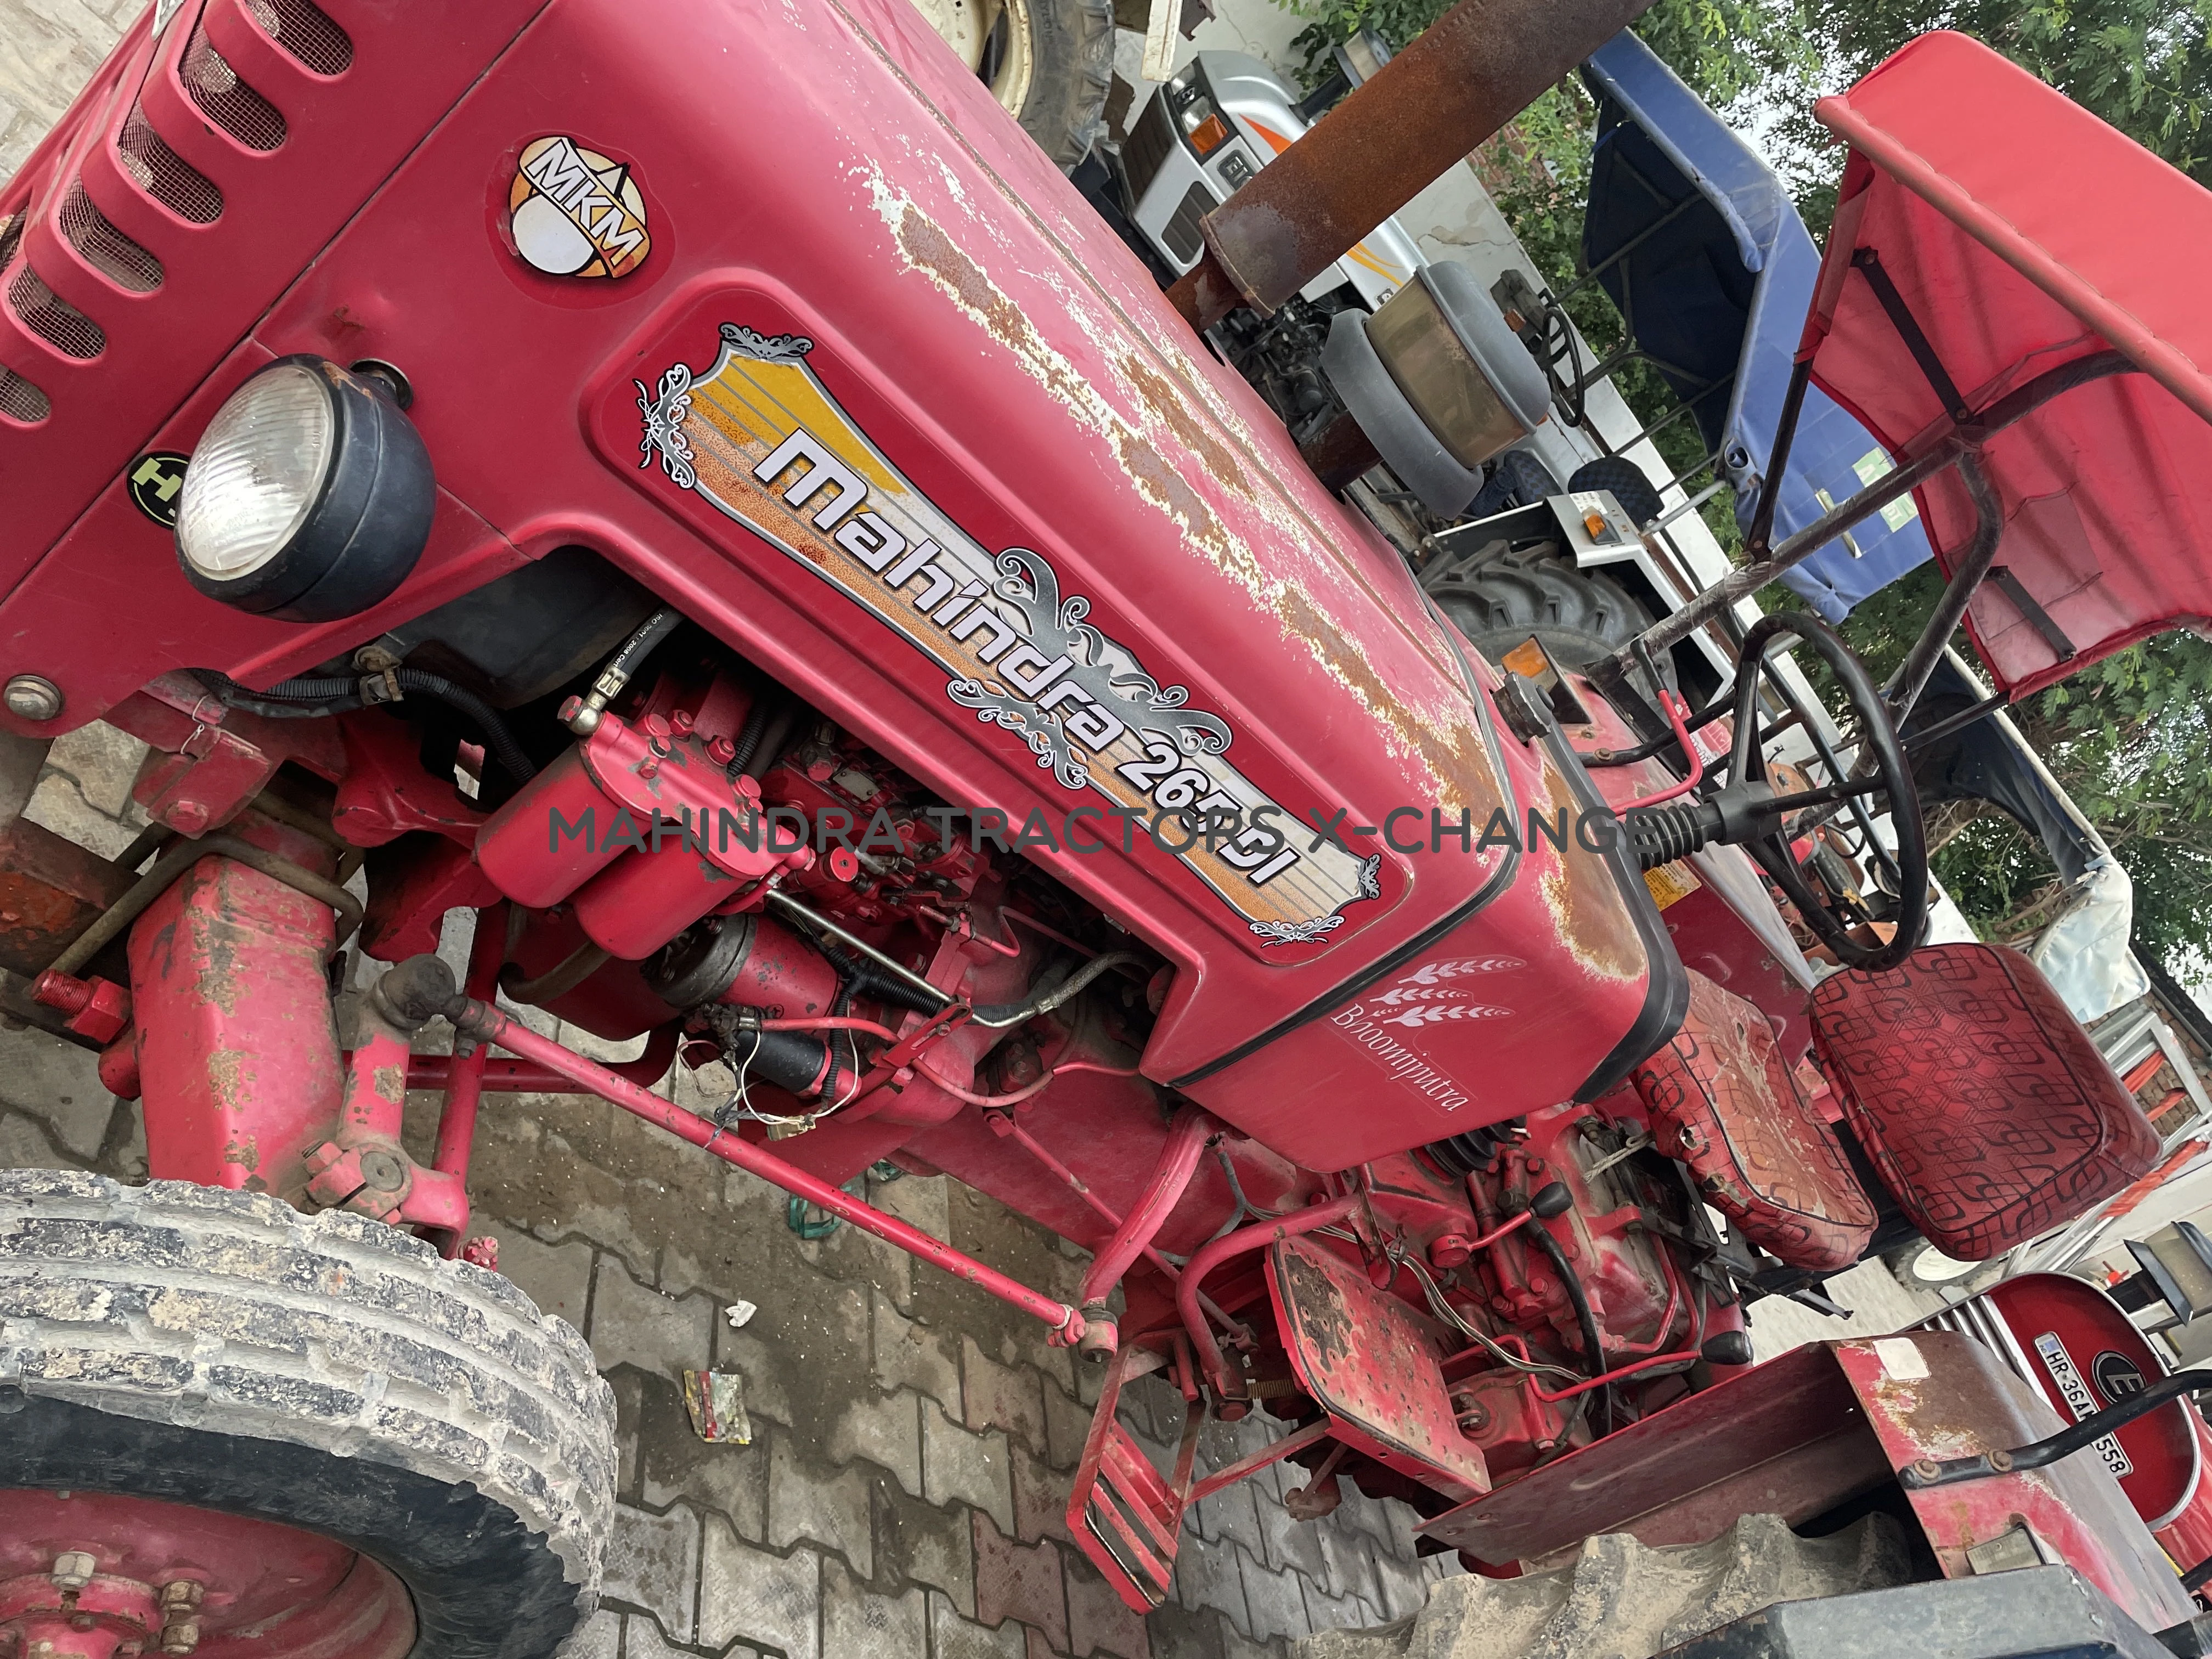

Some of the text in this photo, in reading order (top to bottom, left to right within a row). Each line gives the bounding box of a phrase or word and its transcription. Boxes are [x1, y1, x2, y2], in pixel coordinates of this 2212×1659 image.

[524, 138, 646, 269] MKM
[651, 613, 663, 624] ISO
[752, 427, 1130, 752] Mahindra
[623, 640, 636, 654] 2008
[1330, 1003, 1469, 1112] Bhoomiputra
